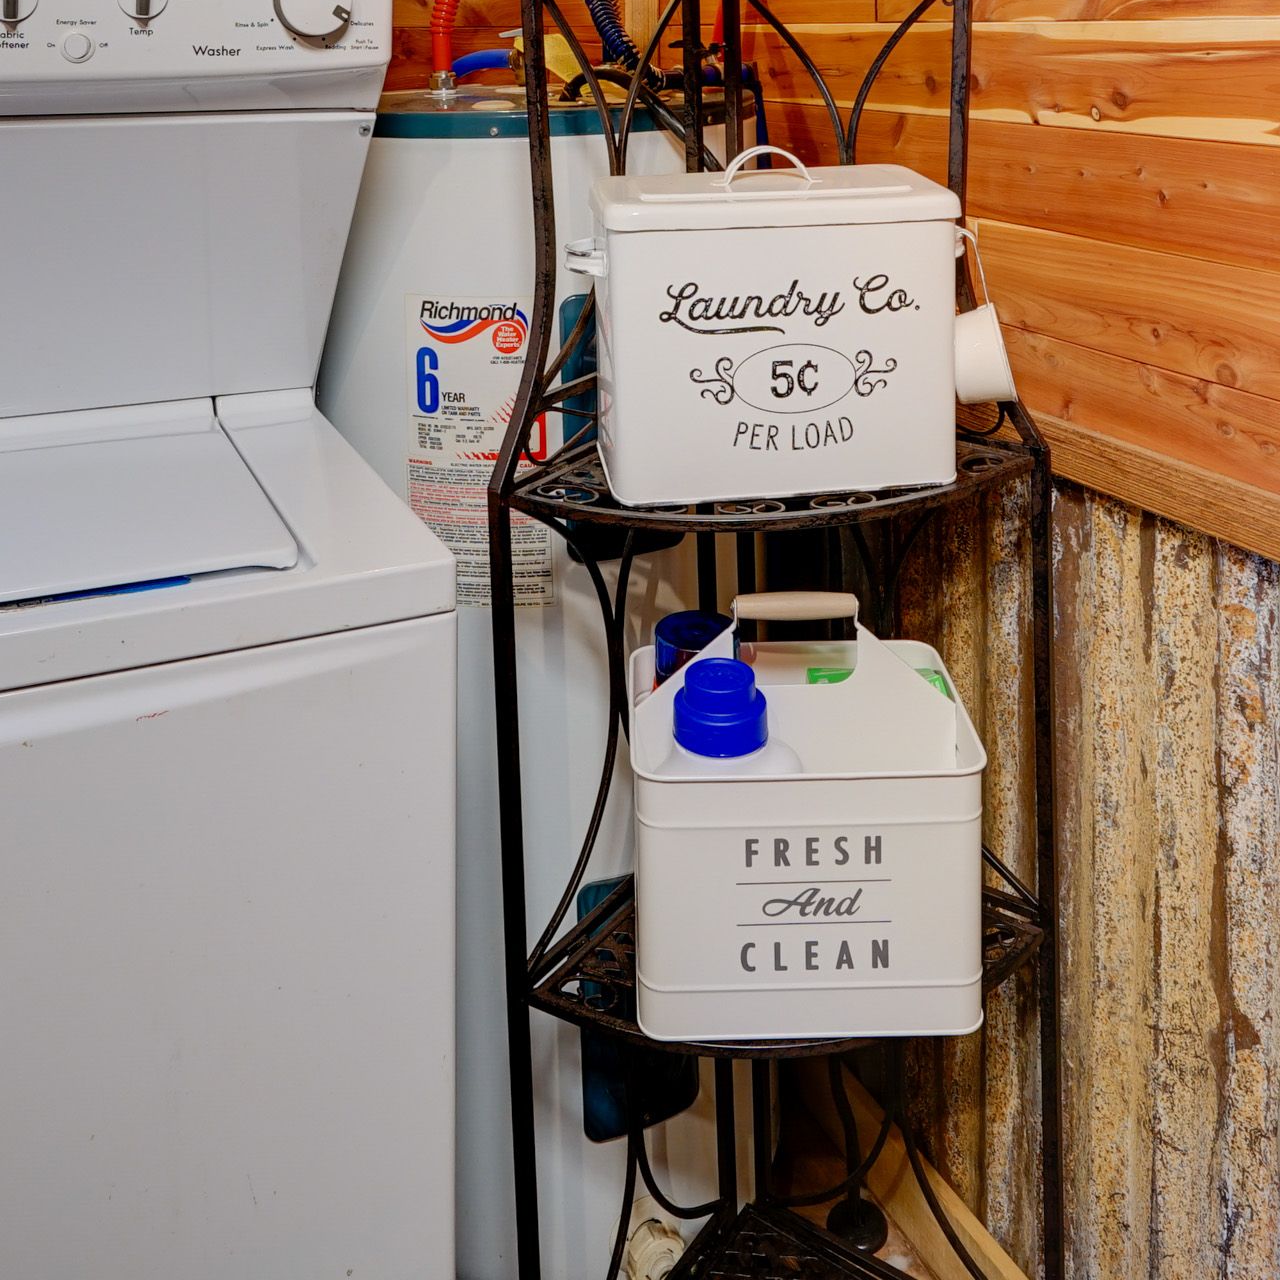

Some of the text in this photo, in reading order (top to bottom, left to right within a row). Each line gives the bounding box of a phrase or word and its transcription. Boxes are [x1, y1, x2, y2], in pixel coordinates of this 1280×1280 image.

[129, 28, 154, 37] Temp
[192, 45, 242, 57] Washer
[420, 300, 517, 321] Richmond
[659, 273, 921, 334] Laundry Co.
[416, 346, 439, 413] 6
[770, 359, 820, 399] 5¢
[441, 392, 466, 403] YEAR
[733, 416, 854, 451] PER LOAD
[408, 458, 433, 466] WARNING
[745, 835, 883, 867] FRESH
[762, 887, 863, 917] And
[740, 939, 891, 972] CLEAN
